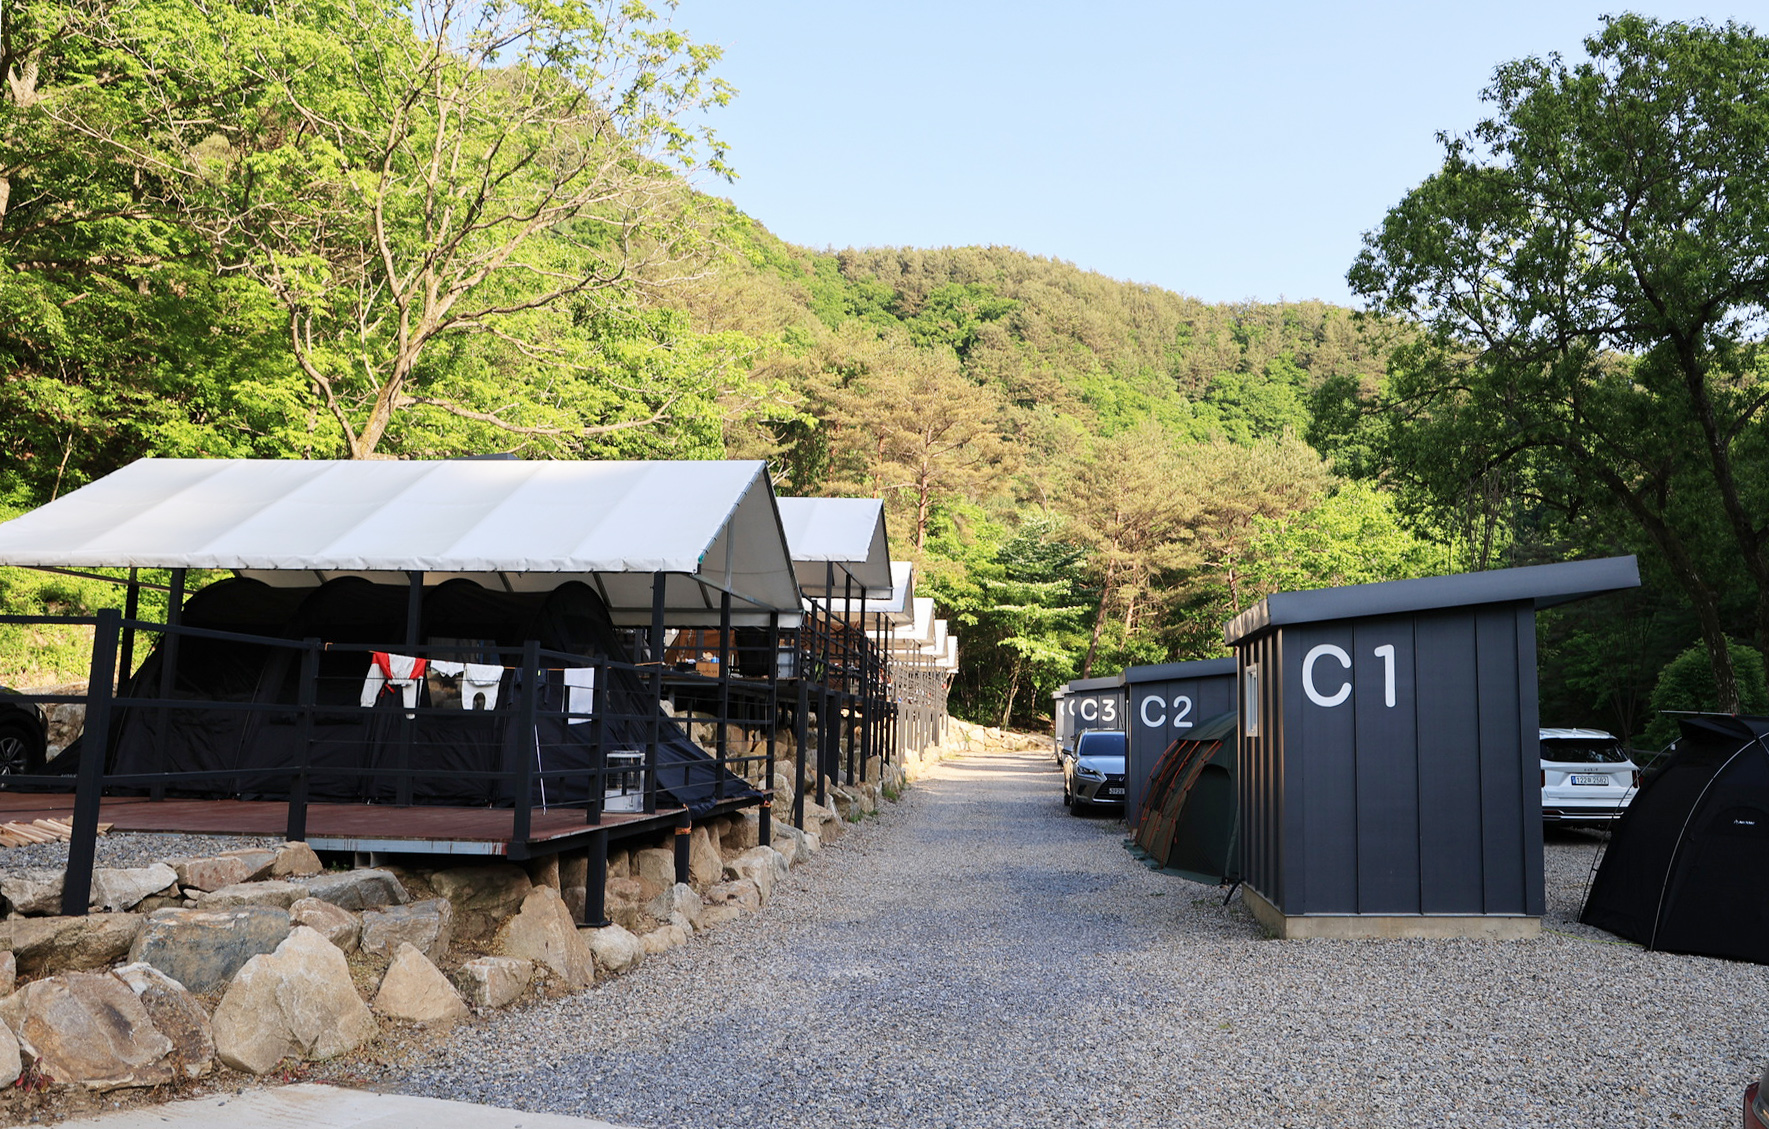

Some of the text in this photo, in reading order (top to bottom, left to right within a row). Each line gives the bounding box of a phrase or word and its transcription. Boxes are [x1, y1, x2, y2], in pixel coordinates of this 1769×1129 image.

[1303, 644, 1396, 708] C1
[1080, 698, 1116, 722] C3
[1140, 695, 1193, 728] C2
